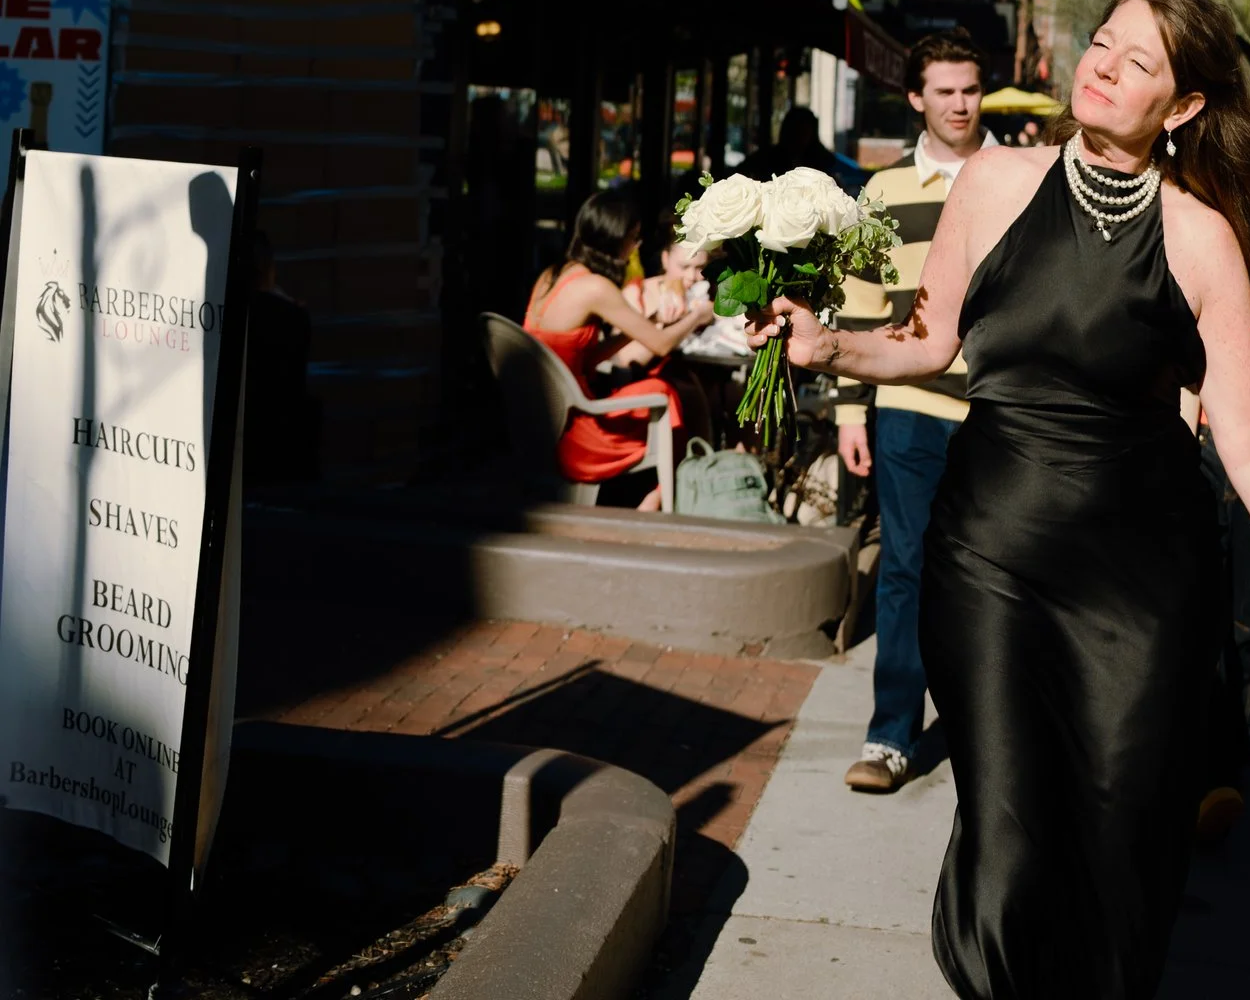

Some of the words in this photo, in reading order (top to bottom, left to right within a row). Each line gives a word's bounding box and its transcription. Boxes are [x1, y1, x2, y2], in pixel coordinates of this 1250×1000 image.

[102, 318, 190, 352] LOUNGE
[72, 417, 196, 472] HAIRCUTS
[88, 498, 179, 549] SHAVES
[92, 579, 172, 629] BEARD
[56, 614, 189, 686] GROOMING
[62, 707, 118, 745] BOOK
[114, 756, 137, 784] AT
